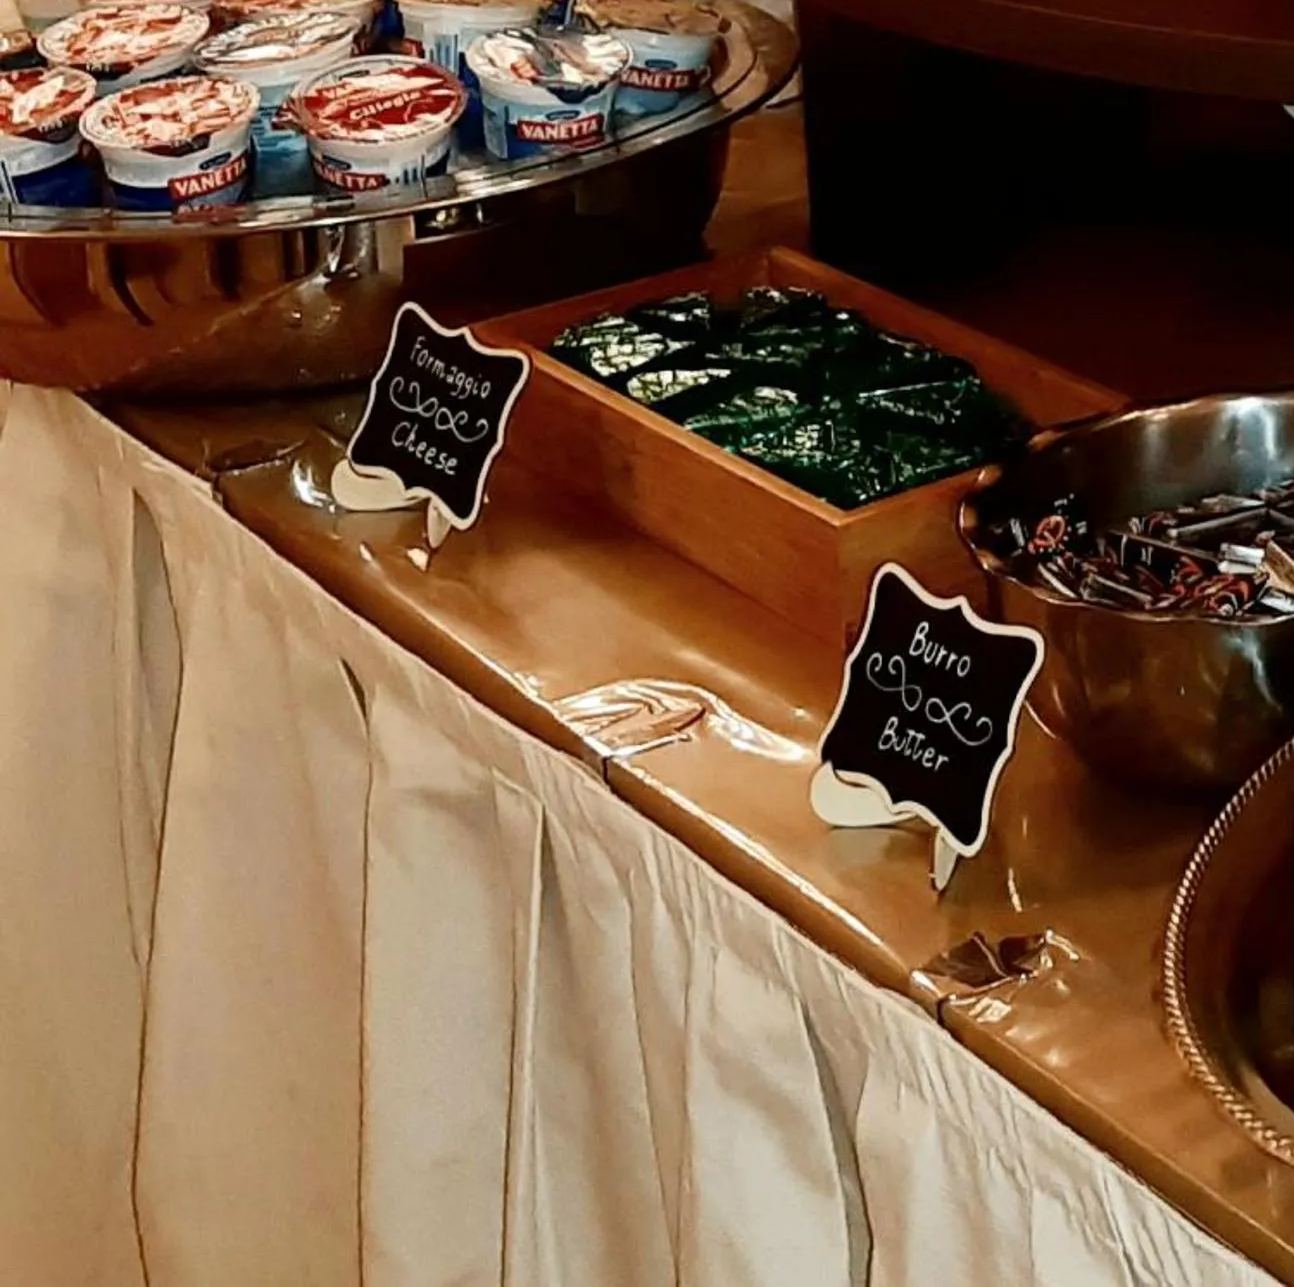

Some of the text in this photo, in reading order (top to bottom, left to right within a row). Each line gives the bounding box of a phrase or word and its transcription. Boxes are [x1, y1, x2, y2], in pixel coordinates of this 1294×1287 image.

[522, 116, 598, 139] VANETTA
[174, 157, 247, 197] VANETTA
[409, 335, 492, 400] Formaggio
[391, 421, 459, 476] Cheese
[908, 621, 971, 678] Burro
[877, 715, 950, 772] Butter
